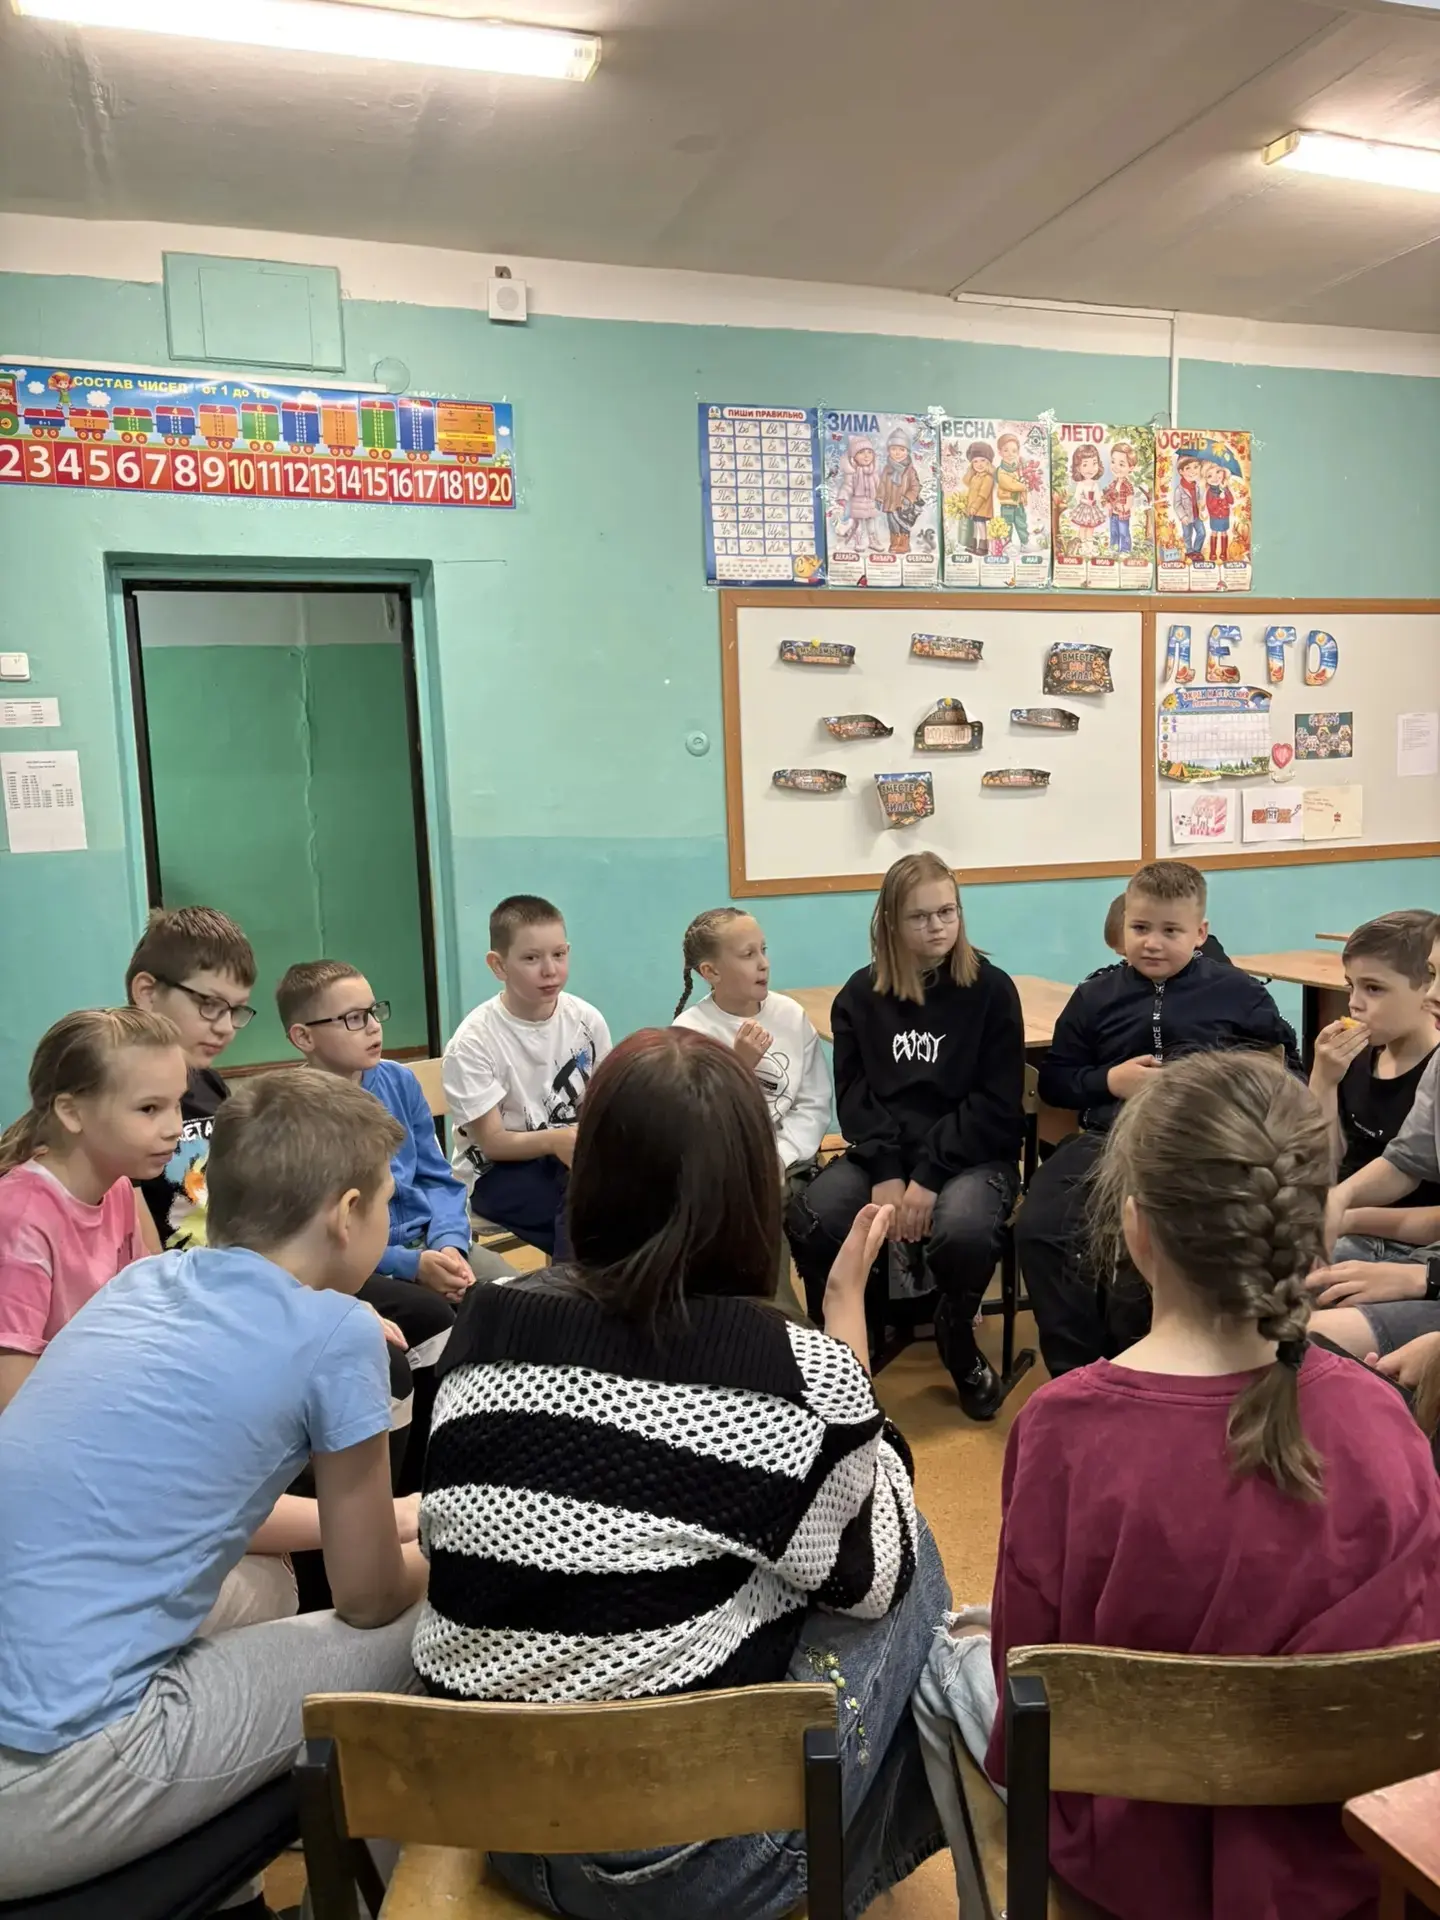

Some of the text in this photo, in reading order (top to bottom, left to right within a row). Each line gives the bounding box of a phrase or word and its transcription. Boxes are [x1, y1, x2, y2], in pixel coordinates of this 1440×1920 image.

[74, 375, 133, 390] СОСТАВ
[137, 380, 188, 394] ЧИСЕЛ
[202, 386, 217, 395] от
[221, 384, 228, 396] 1
[232, 387, 249, 399] до
[728, 409, 753, 418] ПИШИ
[755, 410, 804, 420] ПРАВИЛЬНО
[827, 413, 880, 433] ЗИМА
[941, 420, 996, 439] ВЕСНА
[1060, 425, 1104, 443] ЛЕТО
[1158, 432, 1208, 450] ОСЕНЬ
[0, 444, 512, 502] 2 3 4 5 6 7 8 9 10 11 12 13 14 15 16 17 18 19 20
[907, 555, 932, 563] ФЕВРАЛЬ
[1062, 652, 1094, 662] ВМЕСТЕ
[1065, 671, 1093, 681] СИЛА!
[881, 783, 914, 792] ВМЕСТЕ
[886, 802, 913, 812] СИЛА!
[1153, 1026, 1163, 1049] NICE
